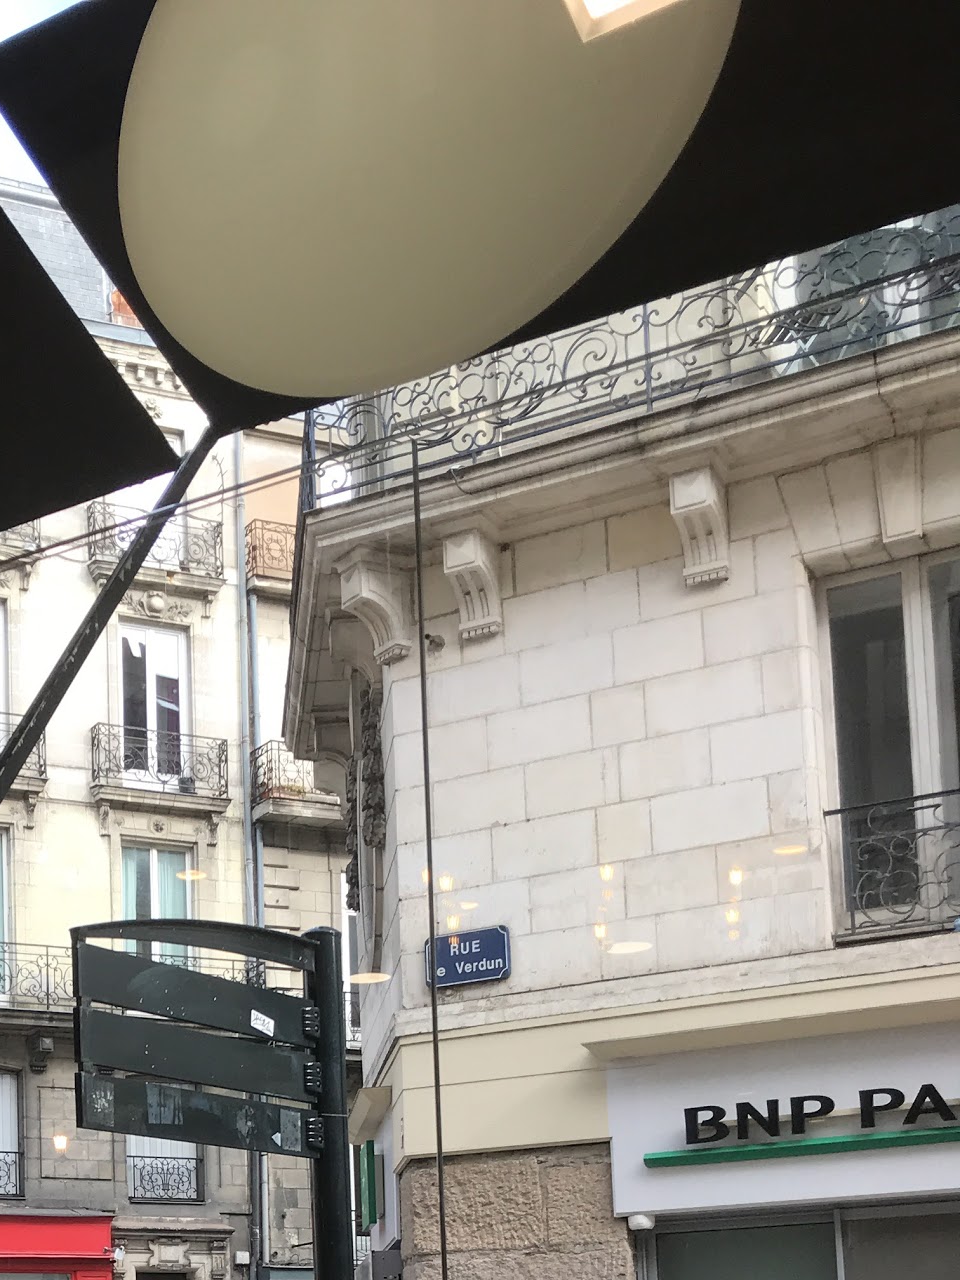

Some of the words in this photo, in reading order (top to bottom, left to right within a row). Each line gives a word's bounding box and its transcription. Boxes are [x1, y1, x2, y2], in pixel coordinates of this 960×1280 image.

[450, 939, 481, 956] RUE
[455, 958, 504, 974] Verdun
[684, 1095, 836, 1145] BNP
